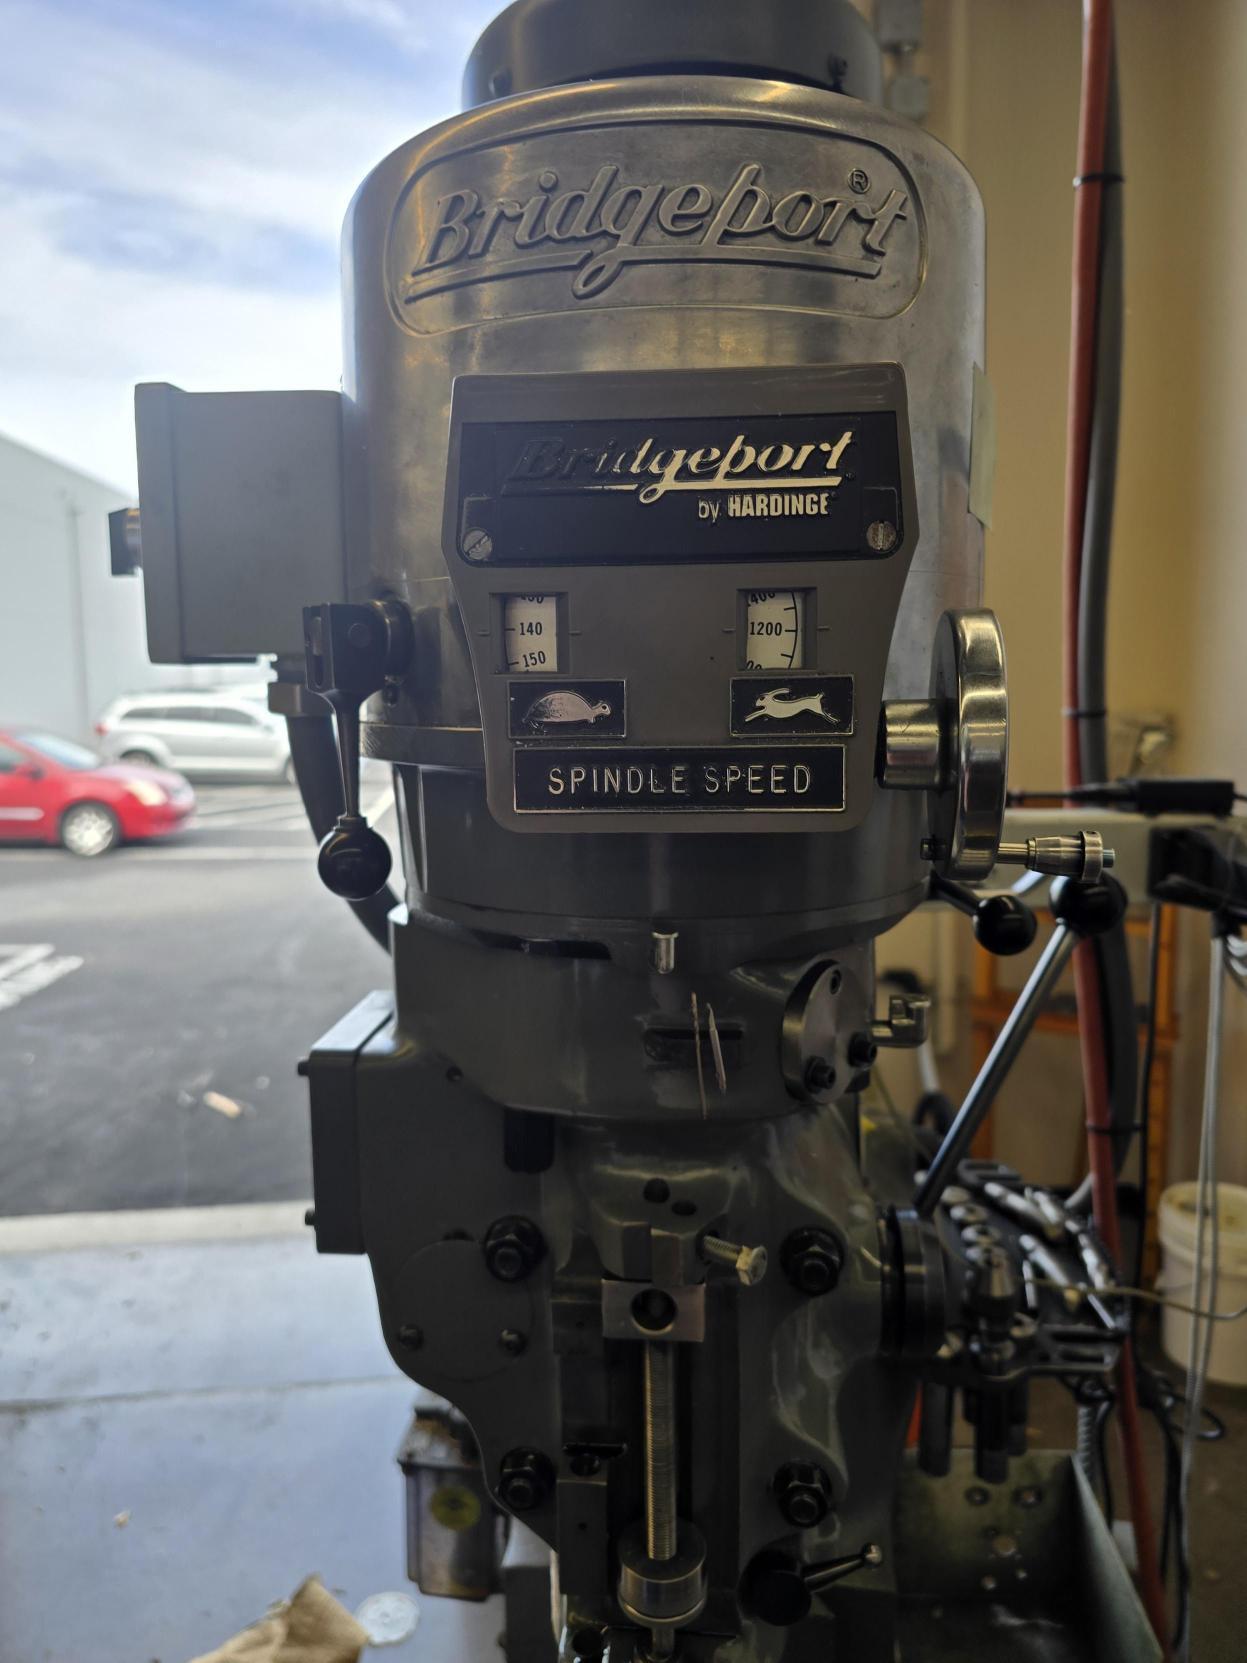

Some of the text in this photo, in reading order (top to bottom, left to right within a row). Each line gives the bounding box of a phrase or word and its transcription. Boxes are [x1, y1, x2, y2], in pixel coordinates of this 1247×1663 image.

[505, 431, 855, 504] Bridgeport
[698, 492, 830, 523] by HARDINGE
[519, 621, 543, 636] 140
[749, 621, 783, 637] 1200
[522, 650, 546, 668] 150
[548, 764, 812, 796] SPINDLE SPEED
